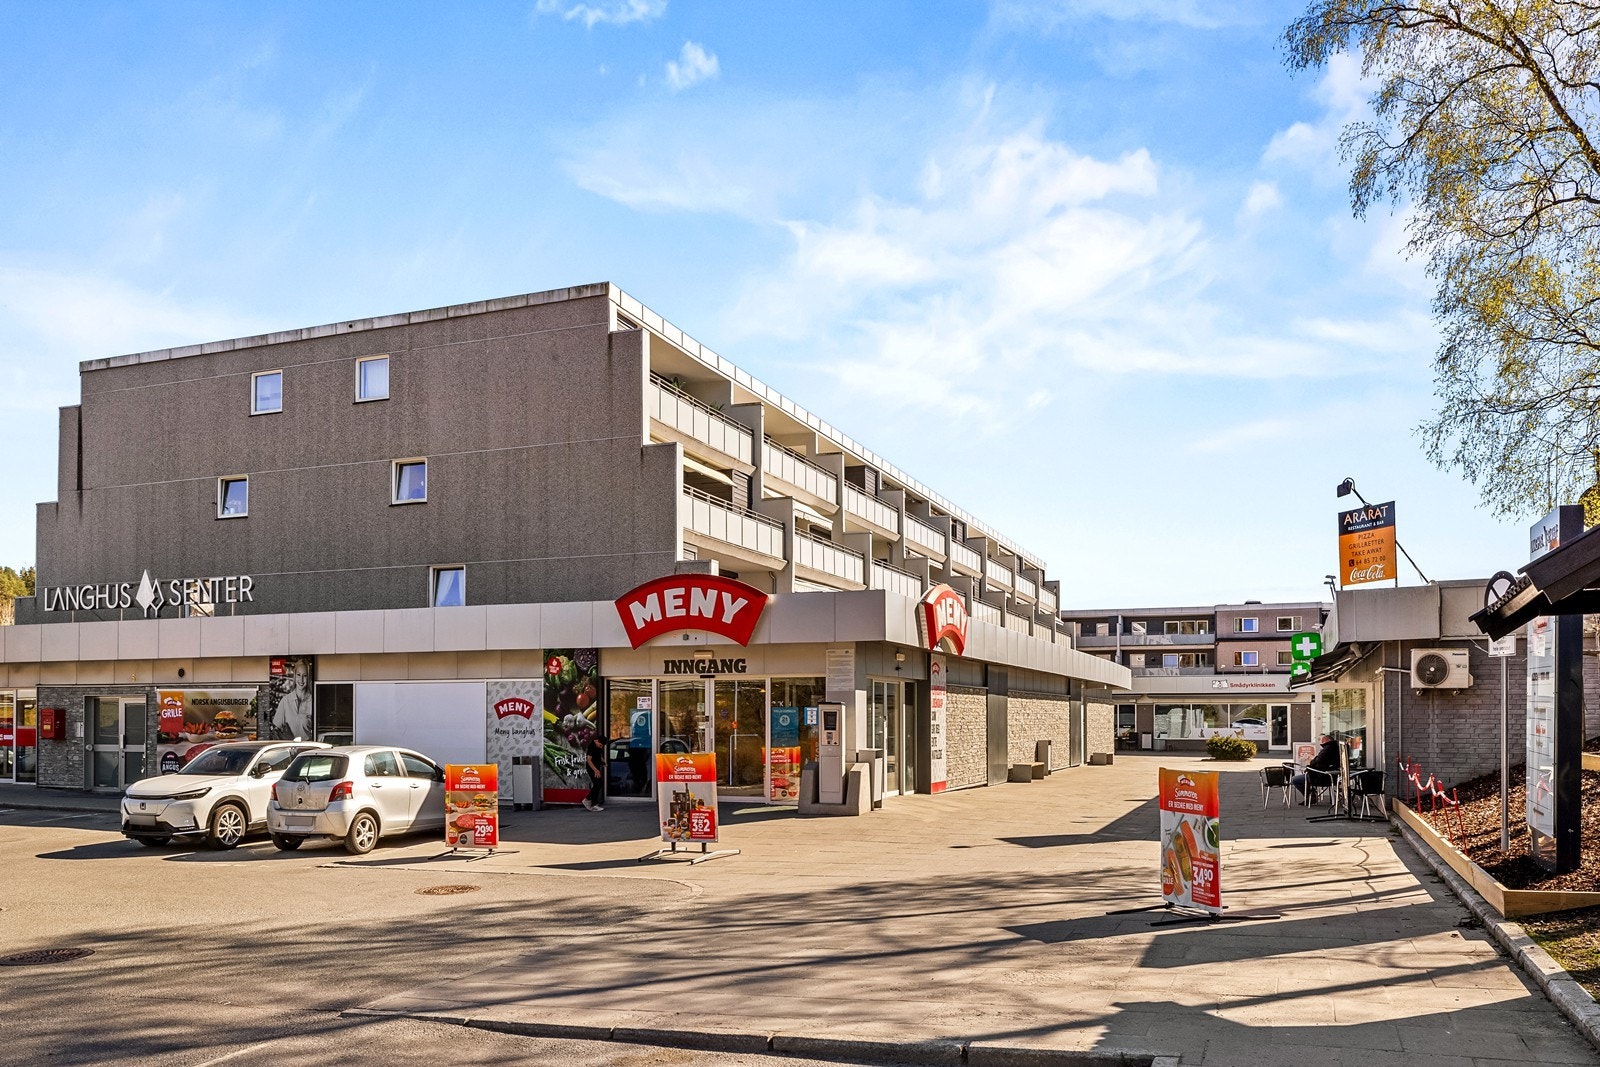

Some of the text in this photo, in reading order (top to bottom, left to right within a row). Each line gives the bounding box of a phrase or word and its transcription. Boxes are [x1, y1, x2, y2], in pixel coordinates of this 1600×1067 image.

[1344, 506, 1388, 525] ARARAT
[1347, 522, 1373, 531] RESTAURANT
[1358, 532, 1375, 540] PIZZA
[1348, 538, 1385, 550] GRILLRETTER
[1366, 547, 1382, 556] AWAY
[1349, 563, 1385, 583] Coca-Cola
[44, 575, 254, 612] LANGHUS SENTER
[628, 587, 749, 630] MENY
[936, 598, 968, 637] MENY
[663, 658, 747, 675] INNGANG
[191, 698, 249, 706] NORSK ANGUSBURGER
[161, 708, 183, 719] GRILLE
[499, 702, 531, 715] MENY
[494, 727, 510, 739] Meny
[162, 764, 180, 772] ANGUS
[554, 757, 569, 767] Frisk
[703, 818, 710, 831] 2
